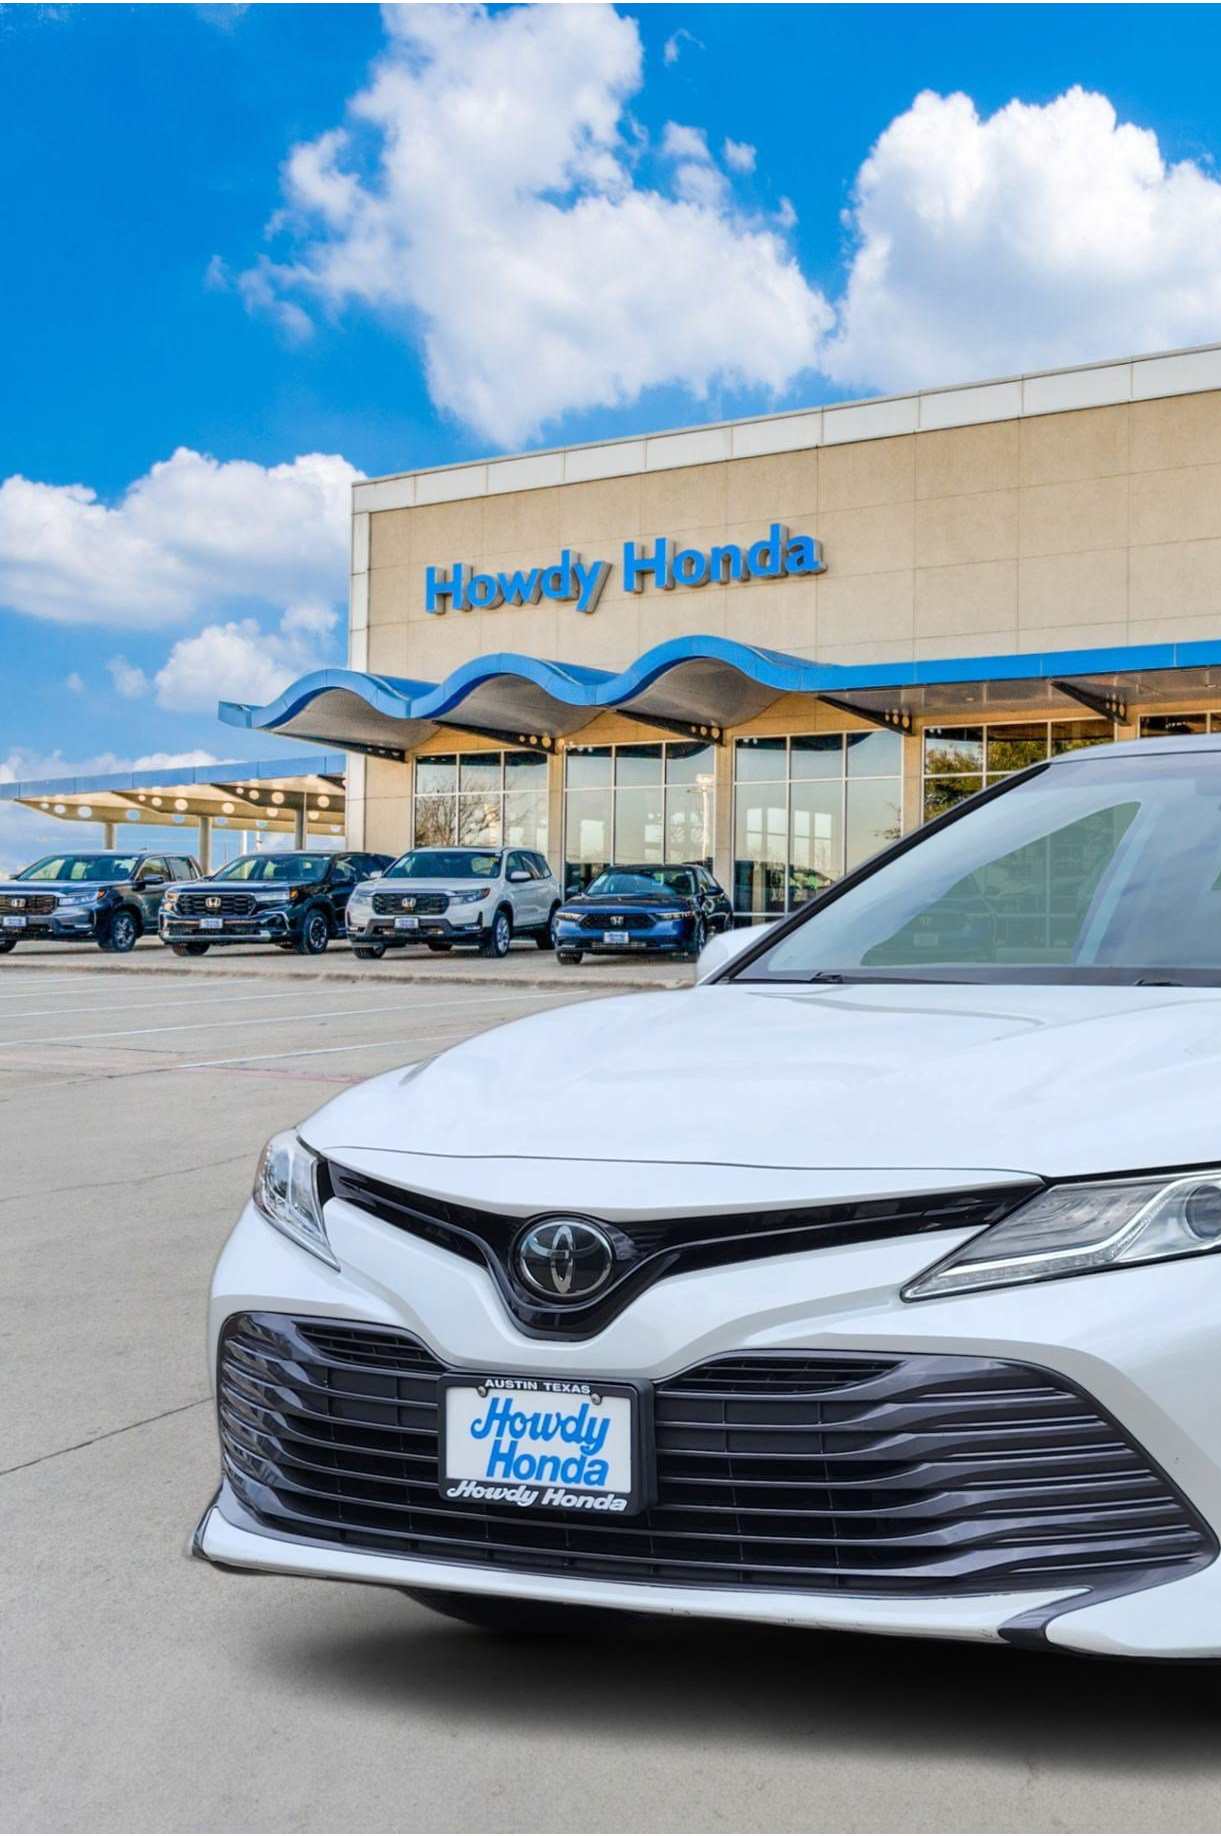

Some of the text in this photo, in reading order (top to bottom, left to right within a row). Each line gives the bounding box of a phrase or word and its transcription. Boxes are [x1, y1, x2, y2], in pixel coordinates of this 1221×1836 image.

[425, 523, 827, 614] Howdy Honda
[484, 1379, 591, 1394] AUSTIN TEXAS
[470, 1397, 611, 1456] Howdy
[486, 1439, 609, 1487] Honda
[447, 1480, 628, 1512] Howdy Honda
